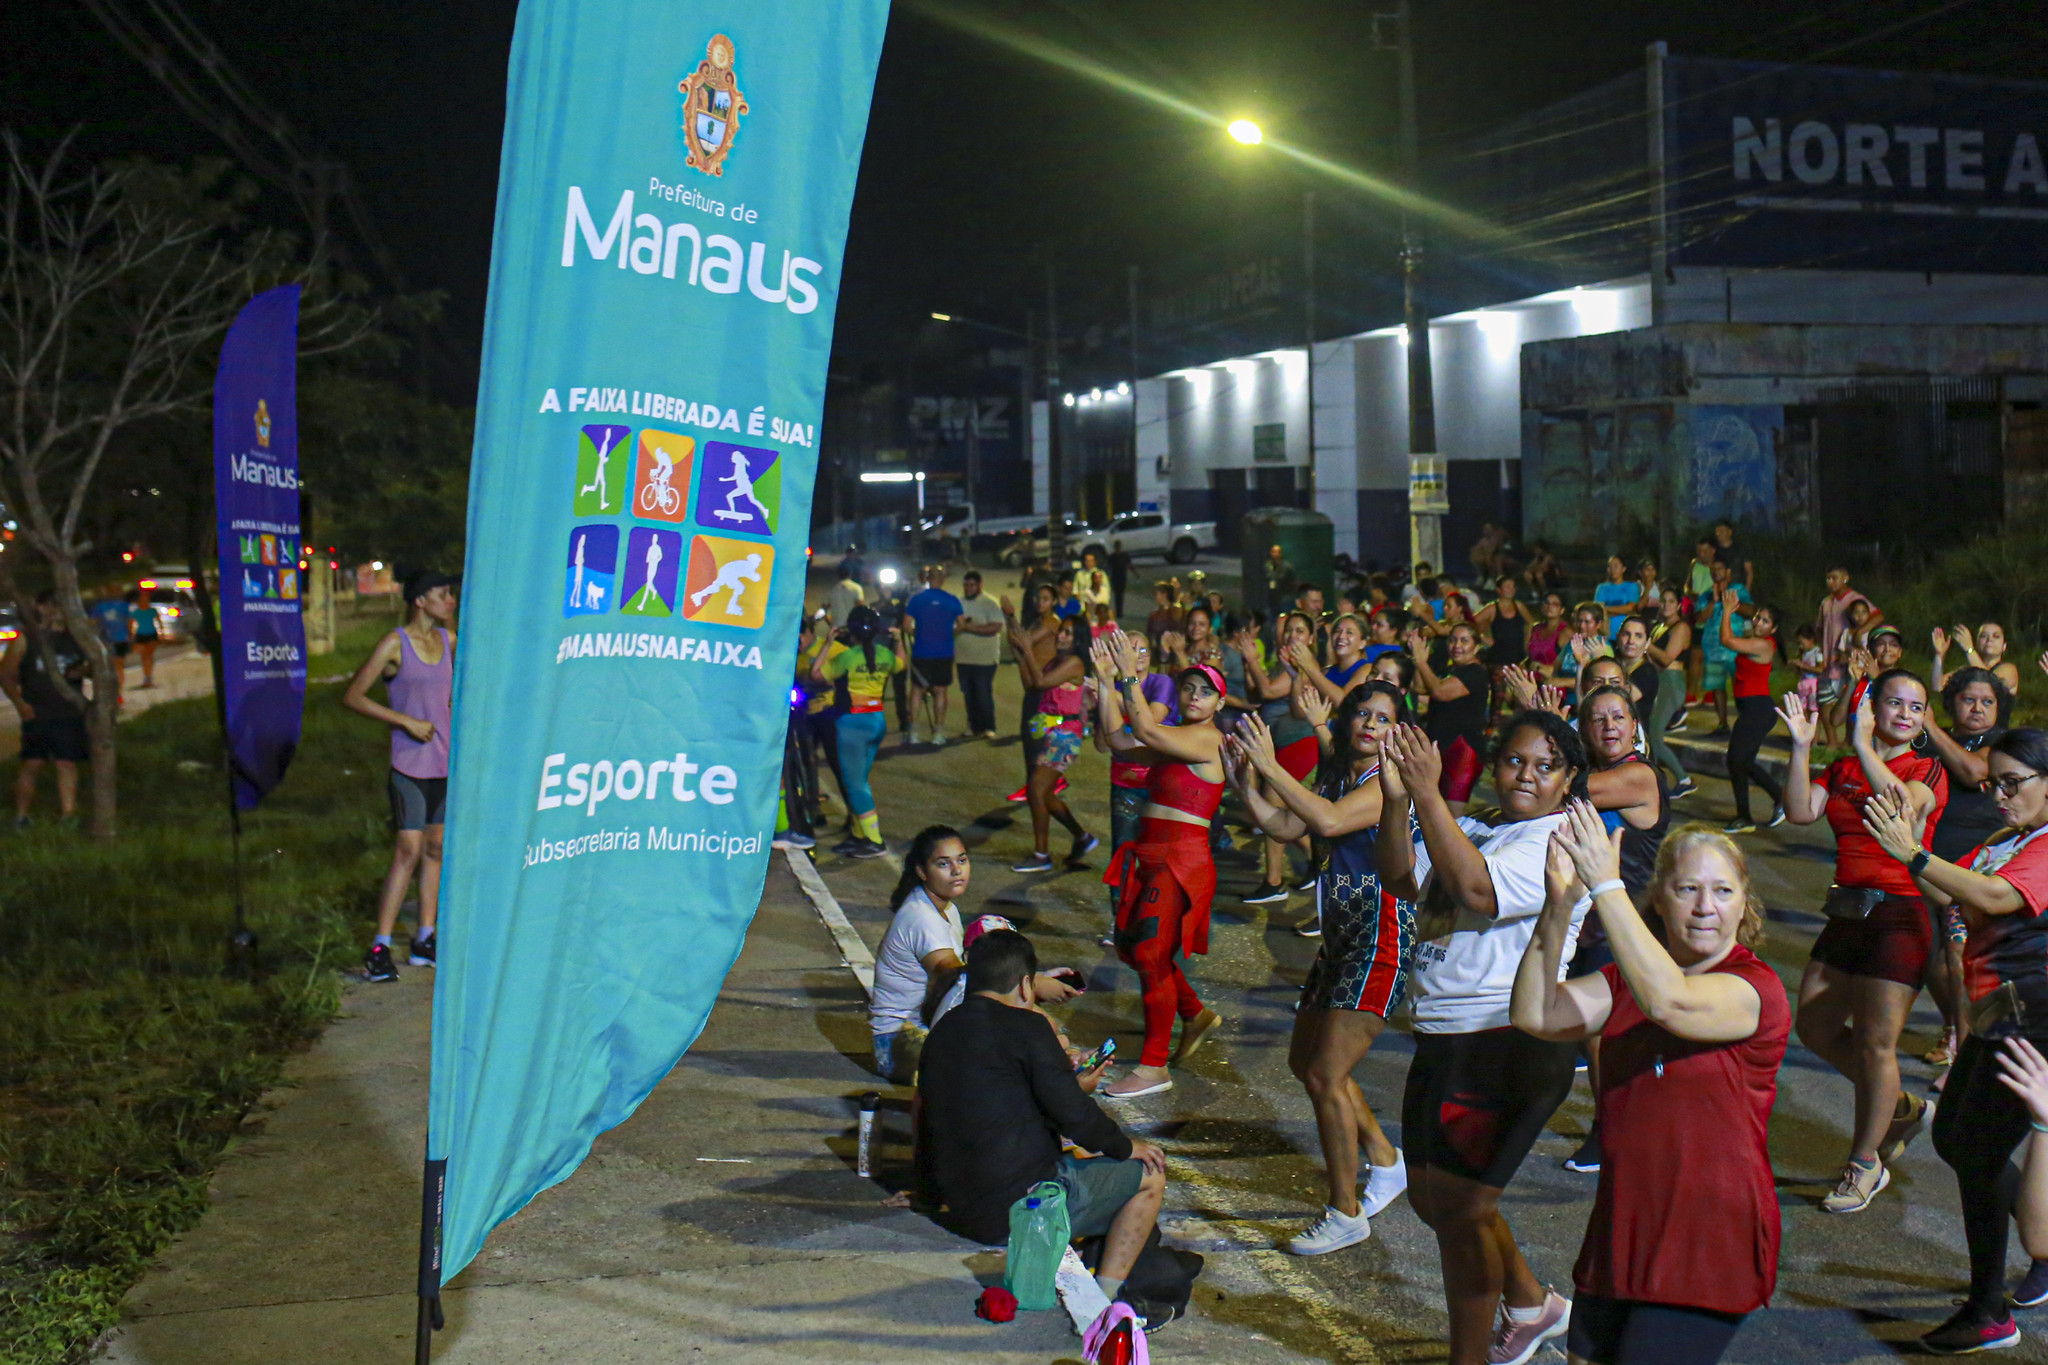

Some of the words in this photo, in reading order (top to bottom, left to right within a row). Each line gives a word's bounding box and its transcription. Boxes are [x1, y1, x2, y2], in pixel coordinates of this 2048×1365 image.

[1733, 116, 1986, 191] NORTE
[649, 177, 725, 217] Prefeitura
[731, 203, 758, 224] de
[561, 186, 823, 314] Manaus
[539, 388, 562, 413] A
[568, 387, 628, 413] FAIXA
[631, 390, 741, 433] LIBERADA
[747, 405, 766, 436] É
[770, 416, 814, 448] SUA!
[231, 453, 297, 489] Manaus
[247, 641, 300, 667] Esporte
[556, 633, 764, 669] #MANAUSNAFAIXA
[537, 752, 738, 817] Esporte
[648, 826, 763, 860] Municipal
